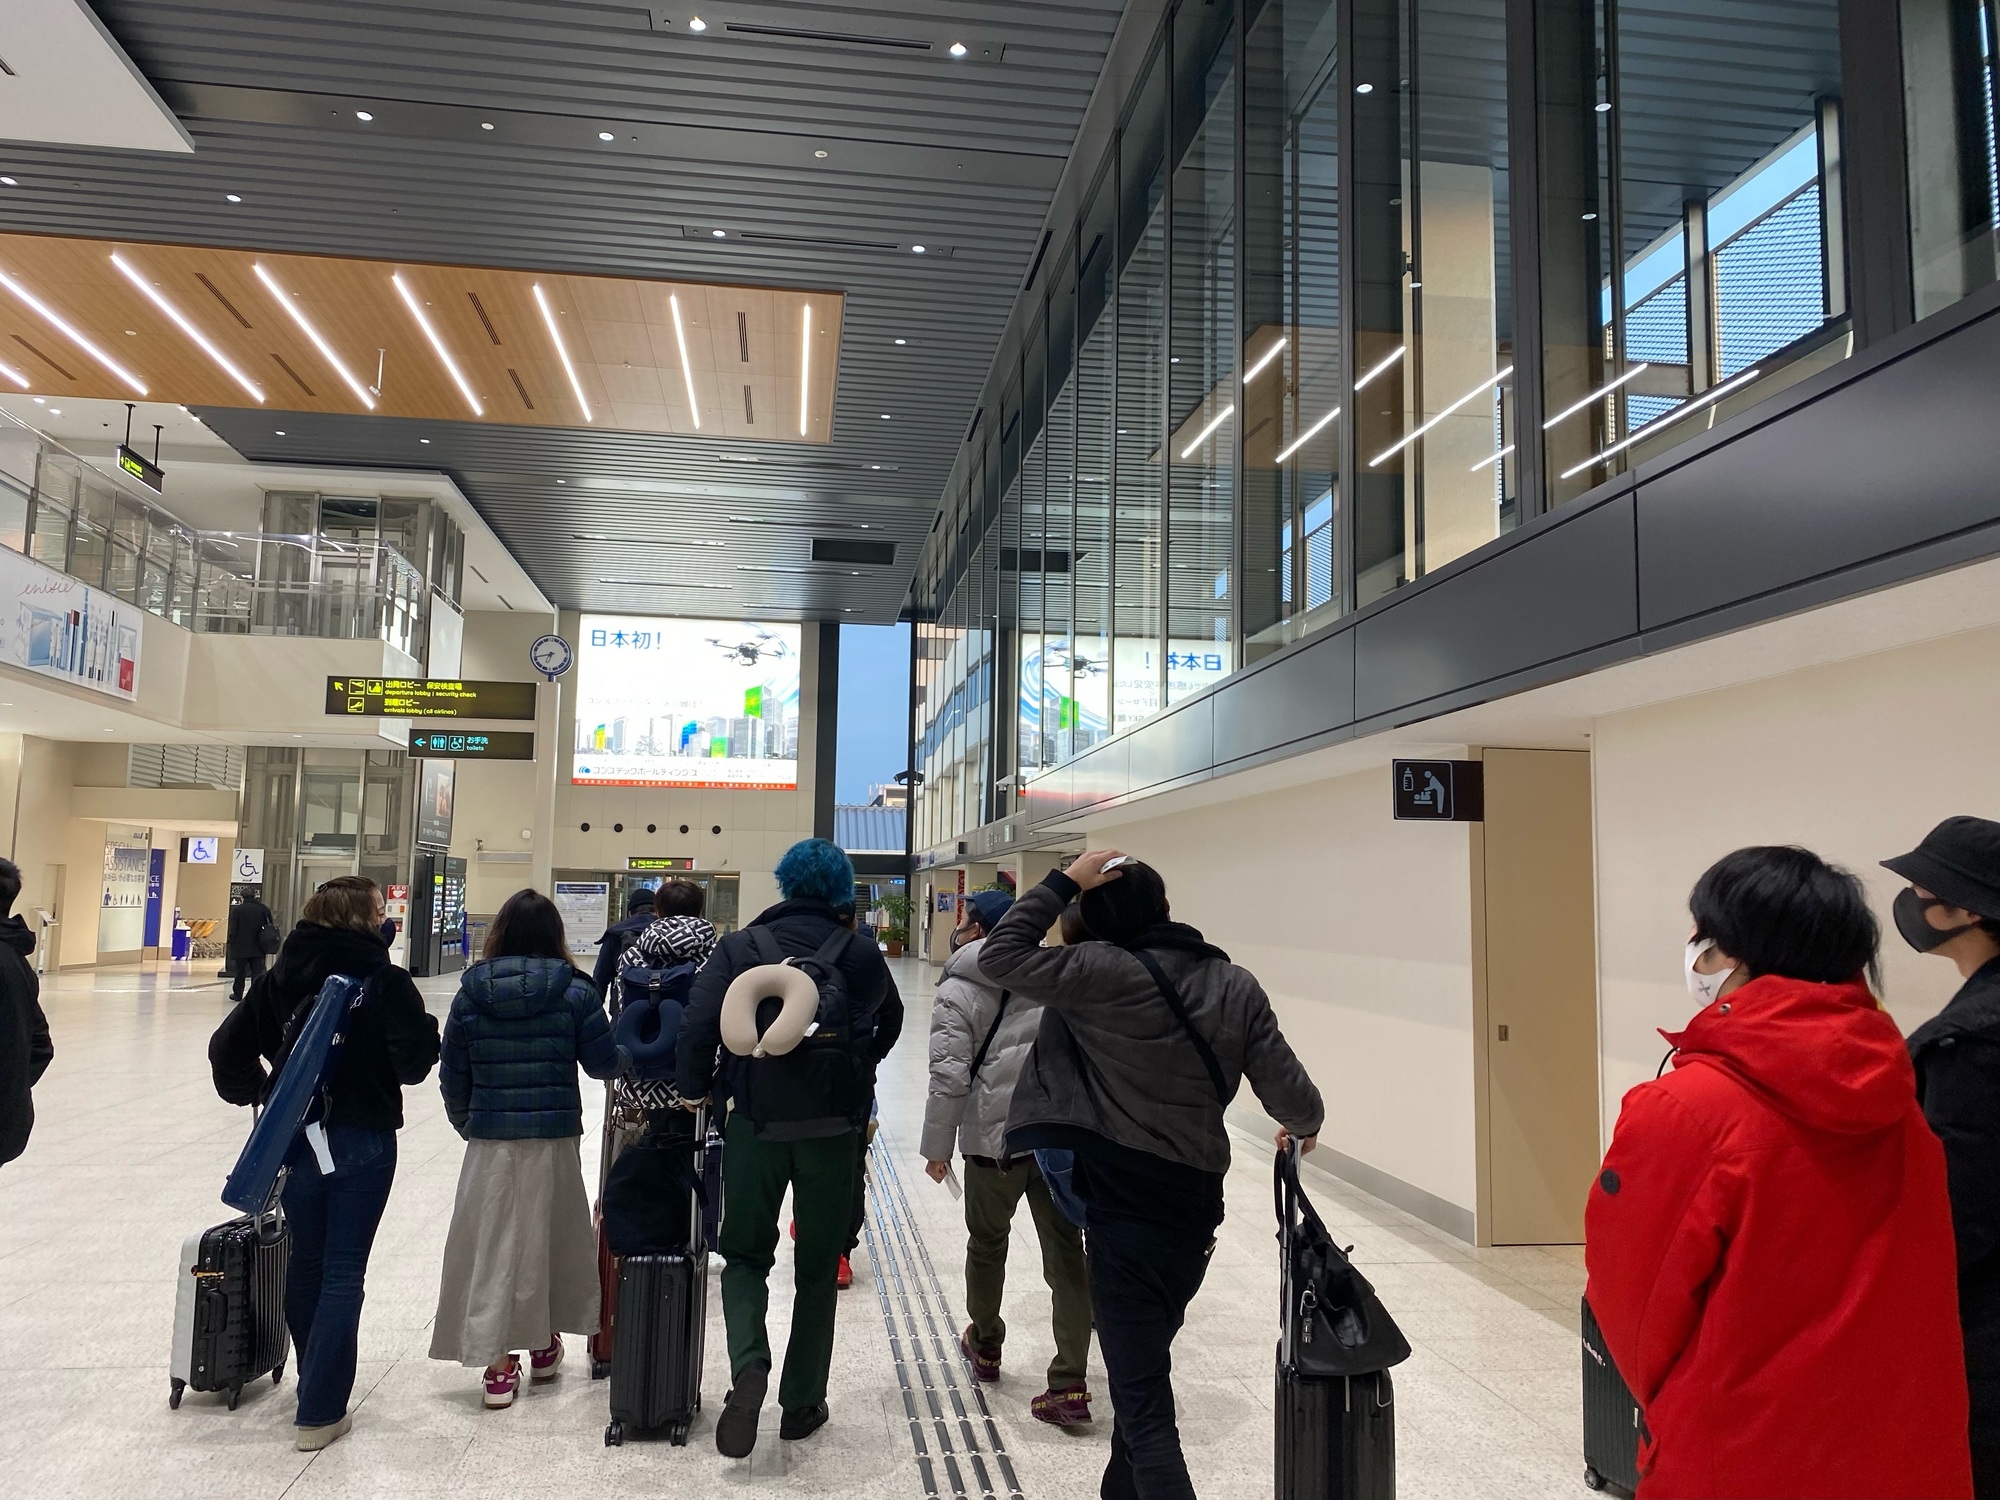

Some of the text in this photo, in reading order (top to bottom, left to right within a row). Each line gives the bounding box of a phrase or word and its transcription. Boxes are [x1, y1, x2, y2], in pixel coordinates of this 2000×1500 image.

[592, 629, 661, 649] 日本初!
[235, 850, 242, 859] 7
[105, 856, 146, 872] ASSISTANCE
